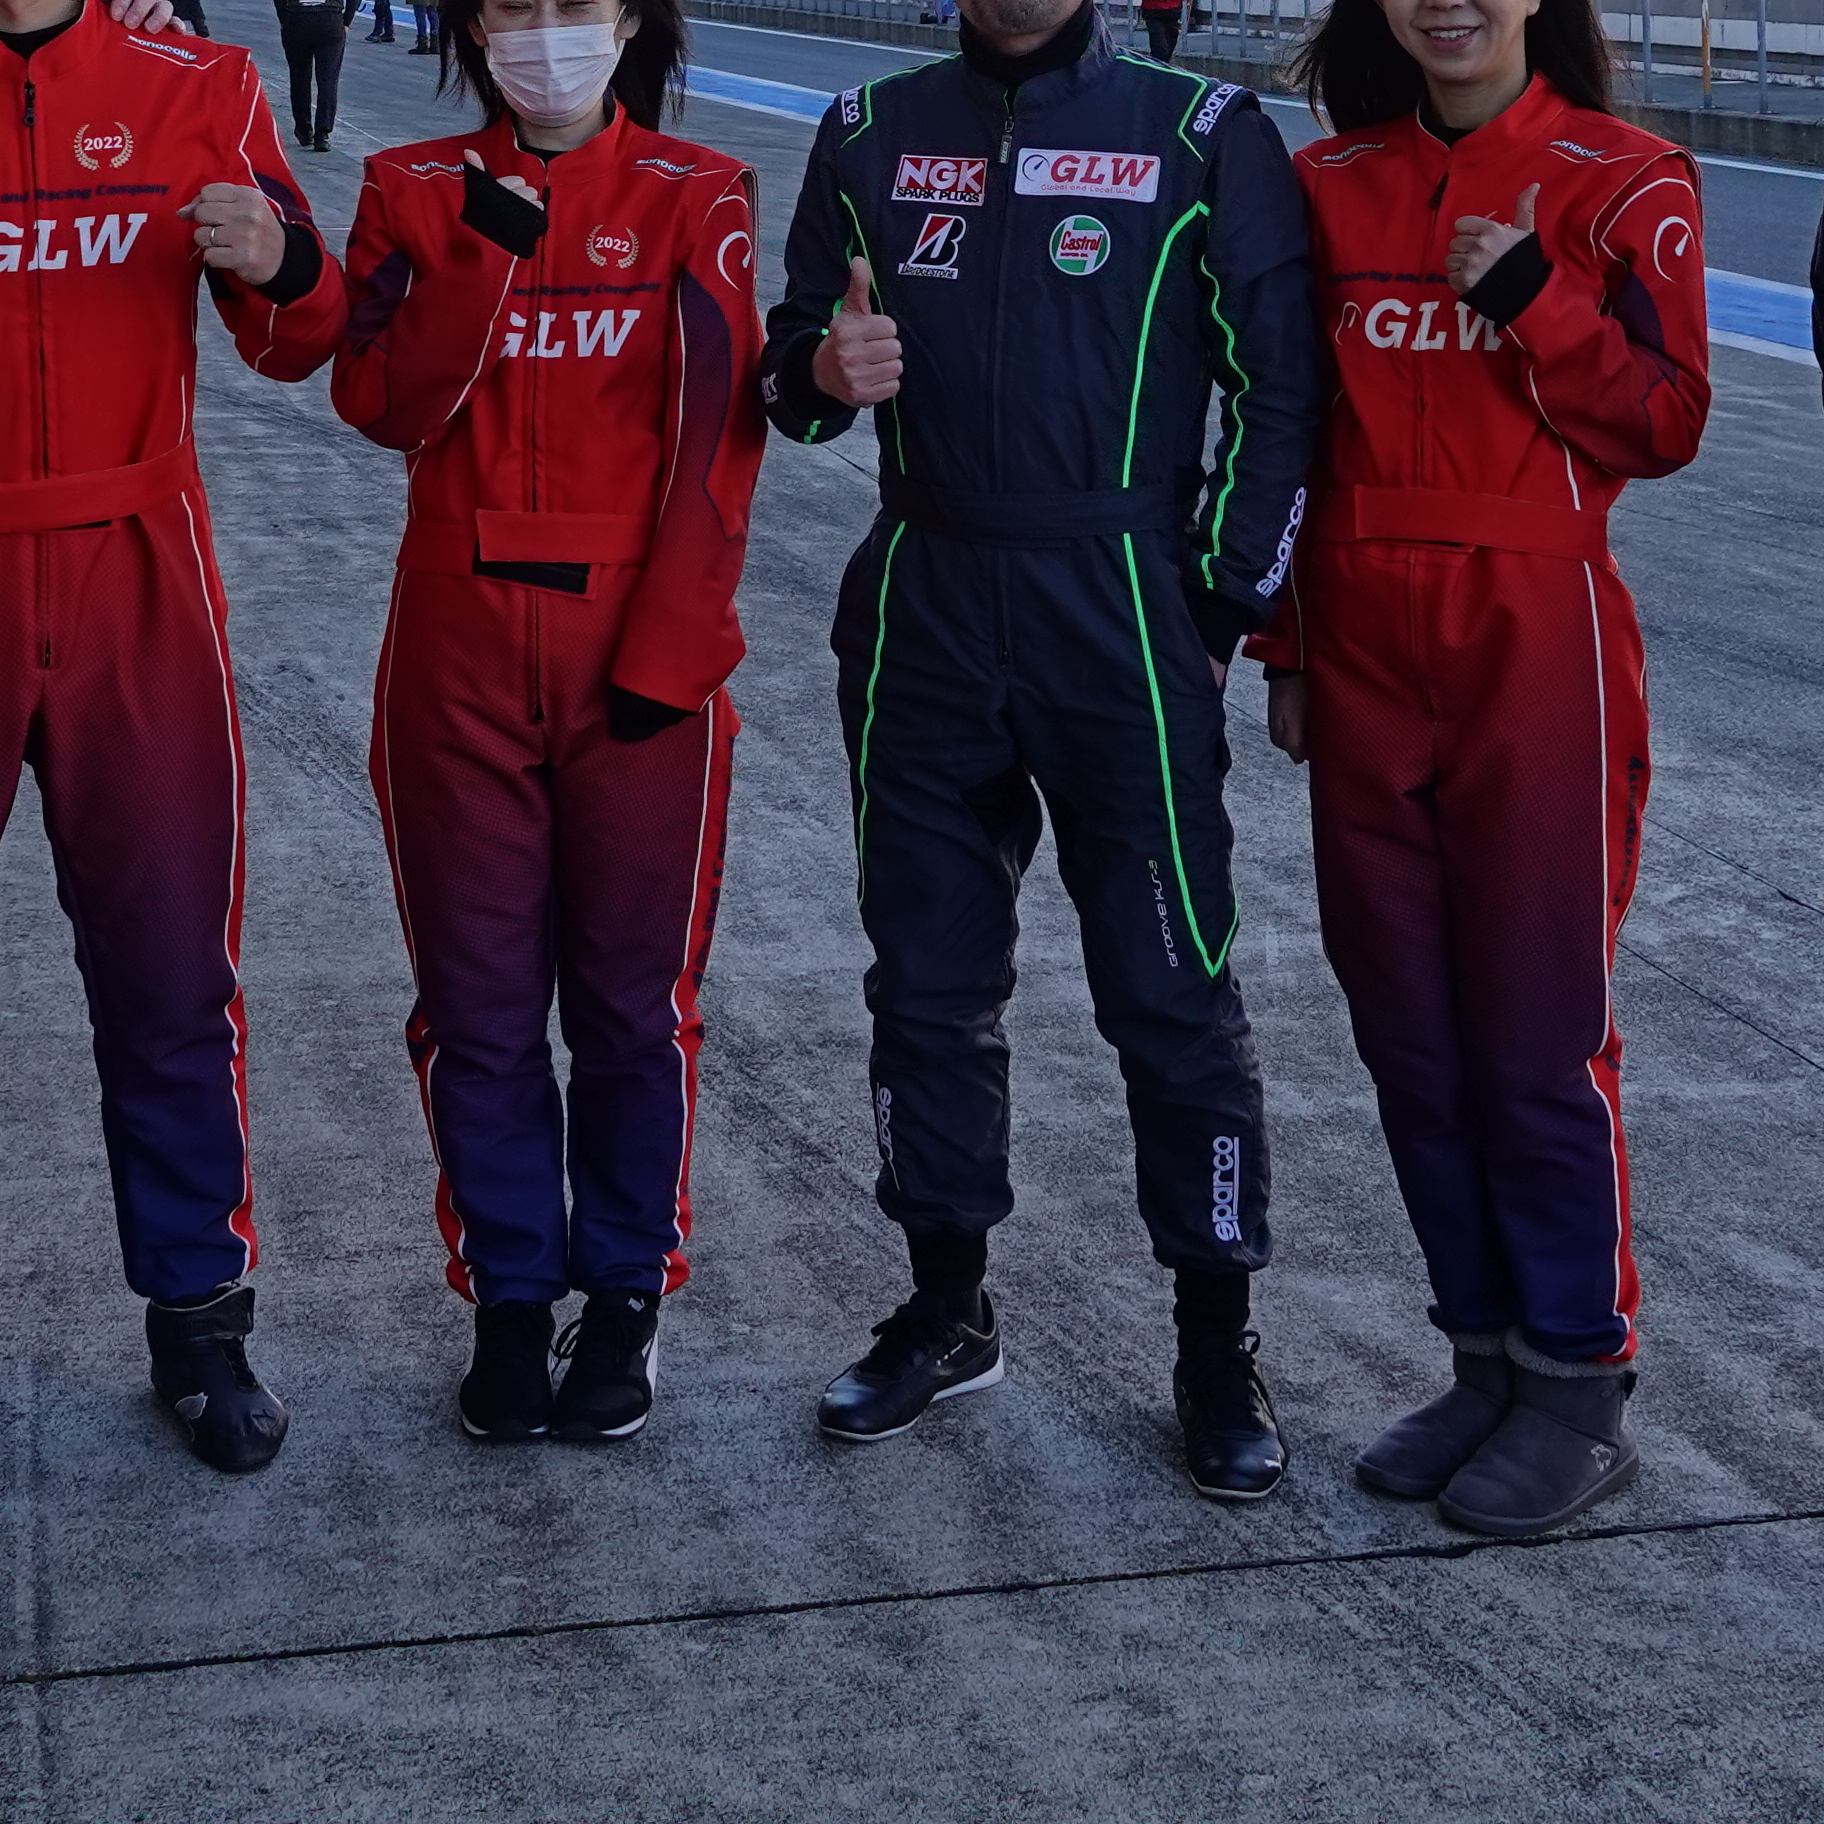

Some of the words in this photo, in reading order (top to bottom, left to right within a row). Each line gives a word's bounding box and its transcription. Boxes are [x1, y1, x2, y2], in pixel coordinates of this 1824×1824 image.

[1192, 83, 1243, 135] sparco
[83, 134, 125, 152] 2022
[898, 158, 985, 193] NGK
[1050, 154, 1155, 188] GLW
[95, 183, 170, 197] Company
[895, 187, 936, 200] SPARK
[940, 191, 981, 204] PLUGS
[594, 236, 631, 253] 2022
[1060, 230, 1103, 251] Castrol
[901, 262, 957, 278] BRIDGESTONE
[1255, 486, 1307, 598] sparco
[1212, 1135, 1243, 1242] sparco
